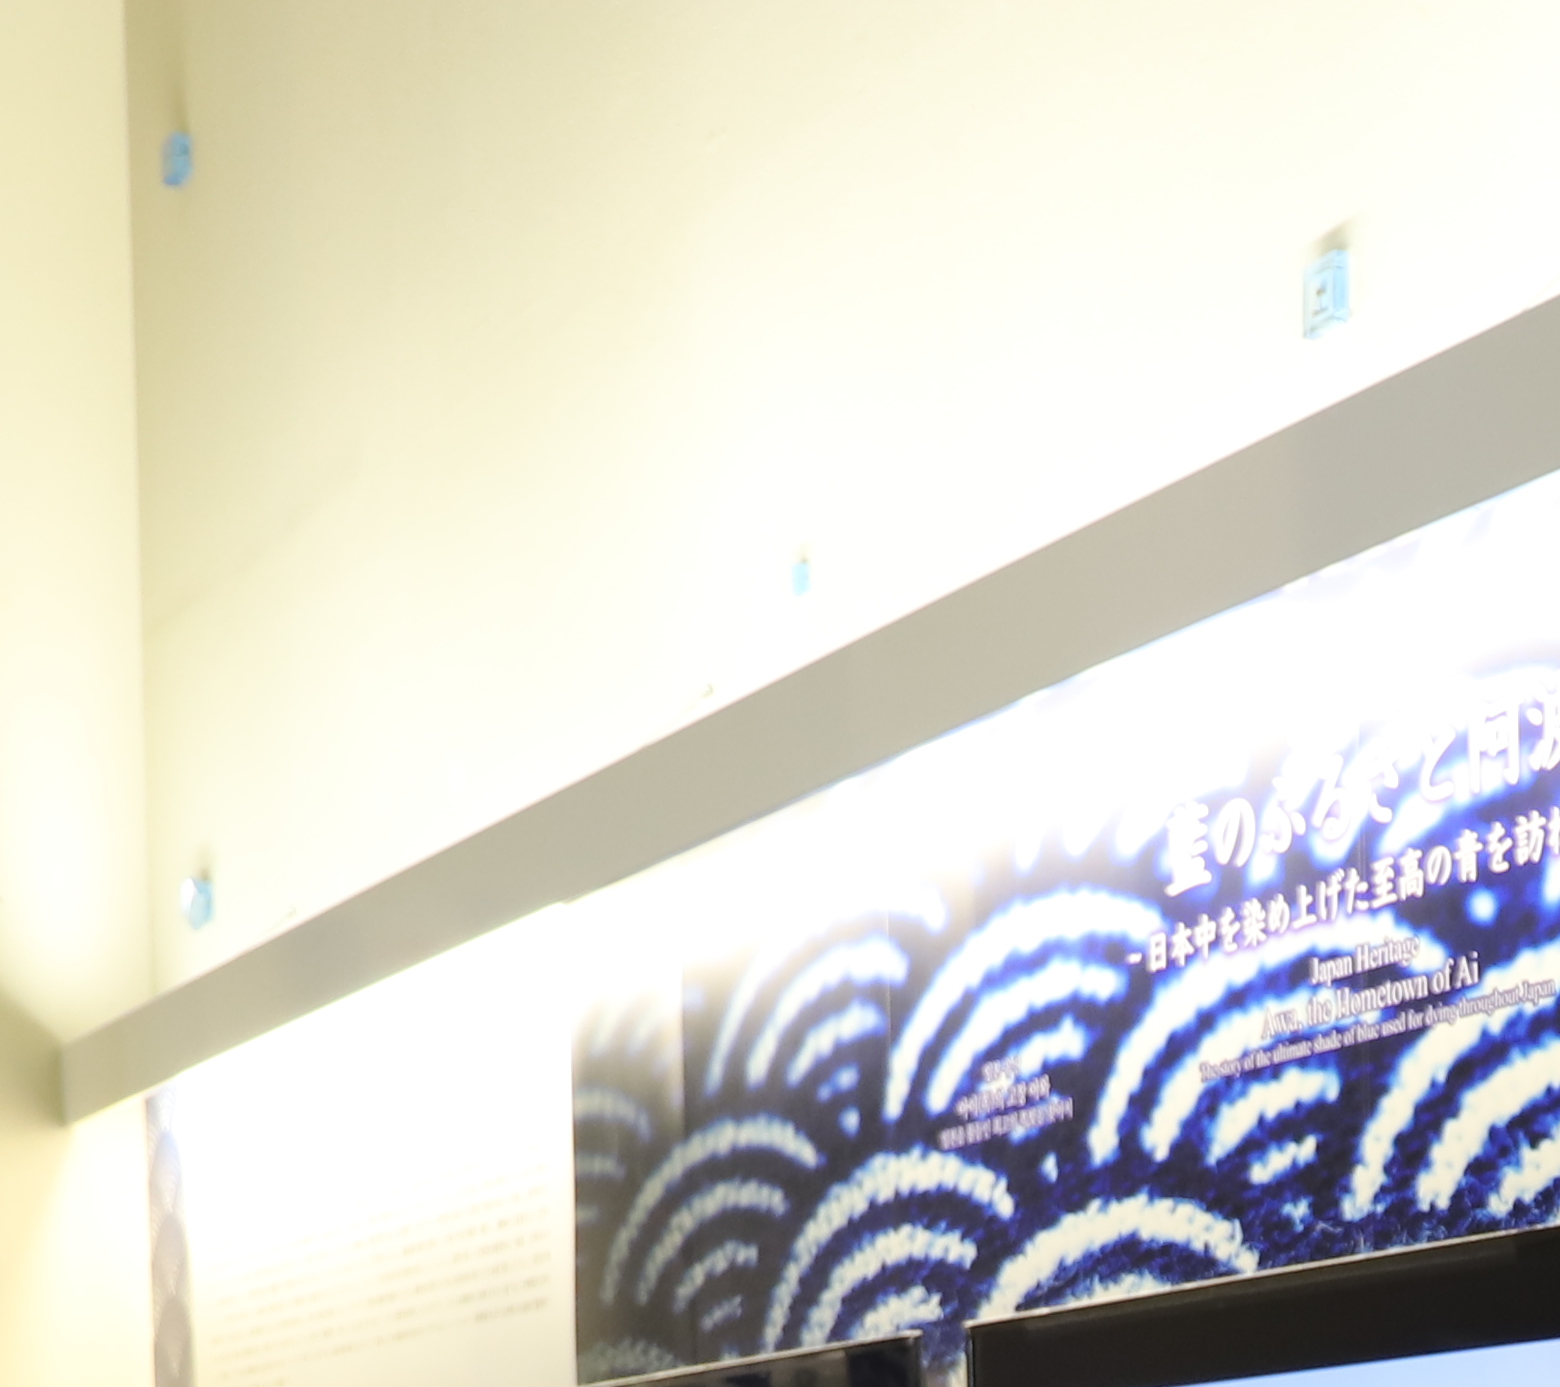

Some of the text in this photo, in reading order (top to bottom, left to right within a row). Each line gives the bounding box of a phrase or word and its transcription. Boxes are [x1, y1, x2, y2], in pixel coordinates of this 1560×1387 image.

[1308, 997, 1332, 1024] the
[1336, 974, 1428, 1019] Hometown
[1430, 965, 1453, 993] of
[1454, 951, 1480, 987] Ai
[1309, 934, 1421, 986] Japan Heritage
